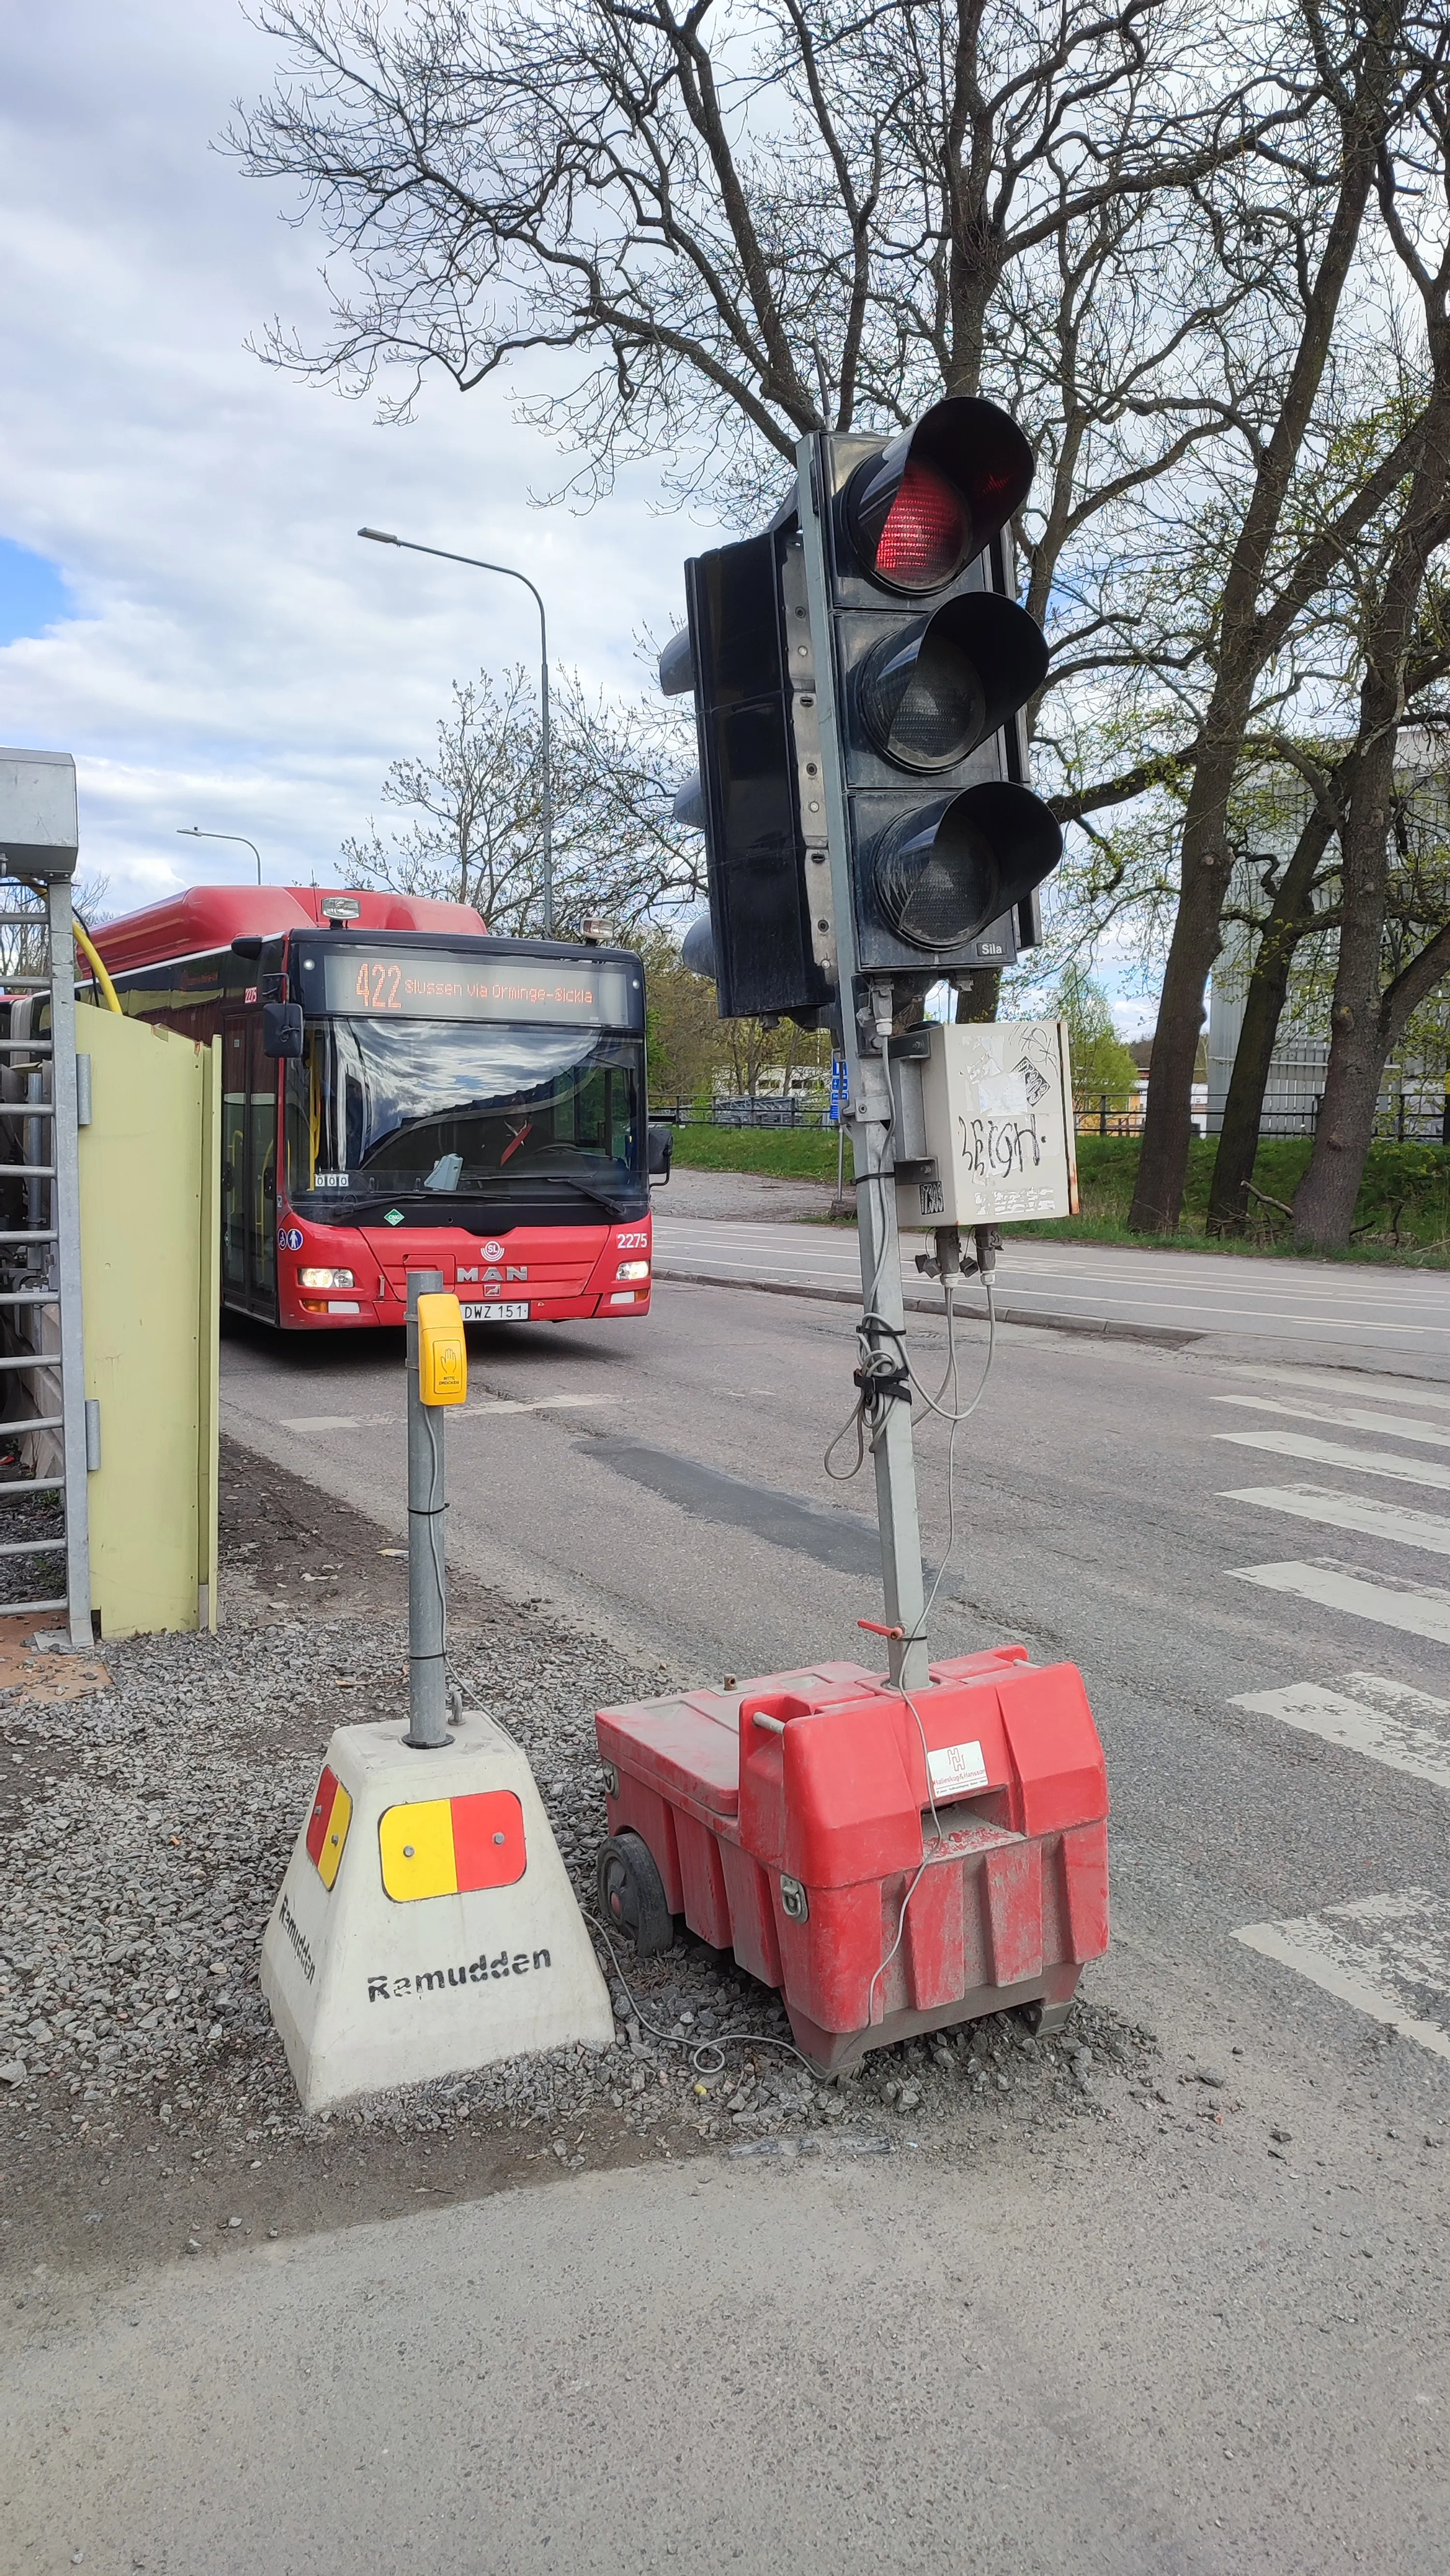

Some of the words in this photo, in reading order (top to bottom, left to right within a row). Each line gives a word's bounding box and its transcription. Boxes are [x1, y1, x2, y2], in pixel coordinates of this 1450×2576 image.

[982, 943, 1002, 955] Sila
[356, 963, 402, 1009] 422
[405, 979, 462, 996] Slussen
[467, 983, 488, 997] via
[487, 1245, 498, 1253] SL
[617, 1233, 648, 1249] 2275
[457, 1266, 528, 1282] MAN
[464, 1306, 492, 1319] DWZ
[498, 1305, 522, 1318] 151
[279, 1893, 316, 1986] Ramudden
[367, 1949, 551, 2003] Ramudden
